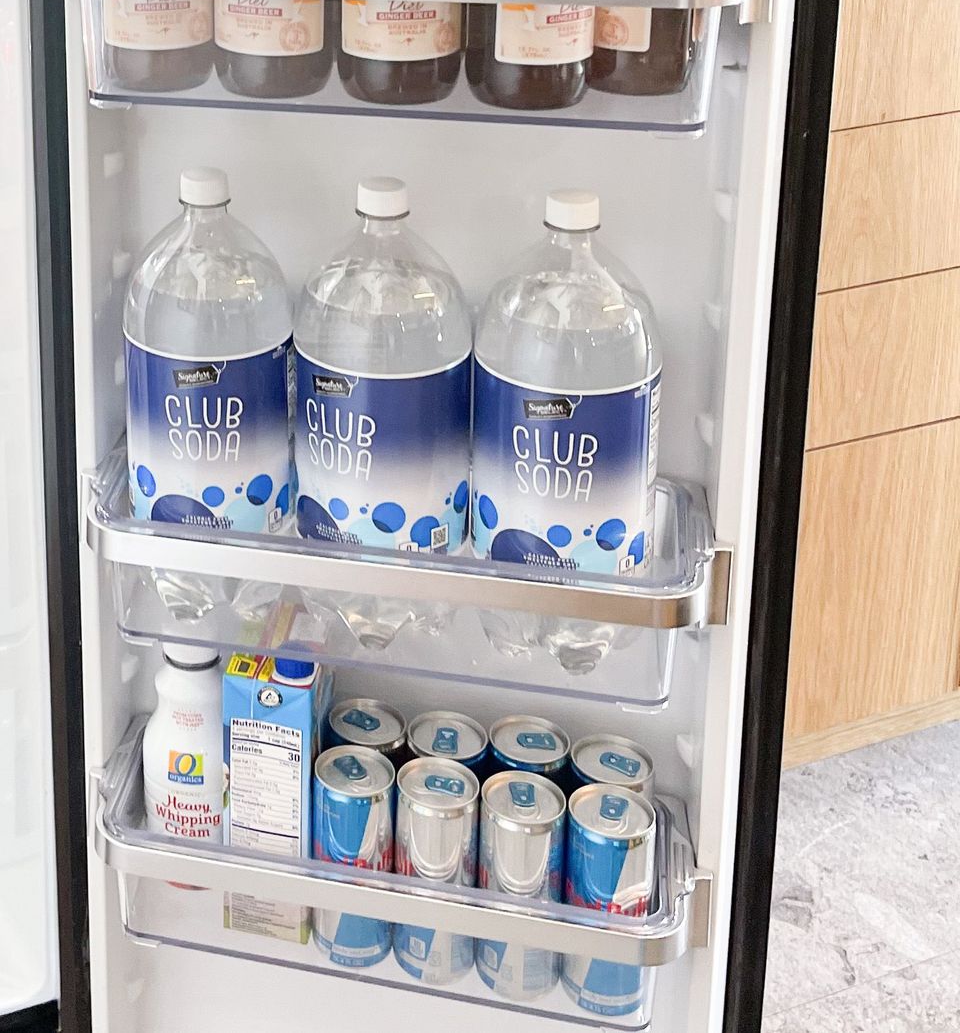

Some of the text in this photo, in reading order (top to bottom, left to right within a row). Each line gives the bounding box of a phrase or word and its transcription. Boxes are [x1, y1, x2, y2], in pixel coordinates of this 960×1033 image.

[230, 5, 280, 16] GINGER BEER
[379, 12, 411, 20] GINGER
[164, 395, 244, 429] CLUB
[306, 398, 376, 447] CLUB
[168, 428, 241, 461] SODA
[512, 425, 599, 467] CLUB
[308, 433, 373, 481] SODA
[514, 461, 594, 502] SODA
[232, 719, 300, 738] Nutrition Facts
[231, 744, 300, 763] Calories 30
[168, 773, 203, 784] organics
[161, 795, 213, 813] Heavy
[155, 804, 221, 829] Whipping
[165, 822, 211, 838] Cream
